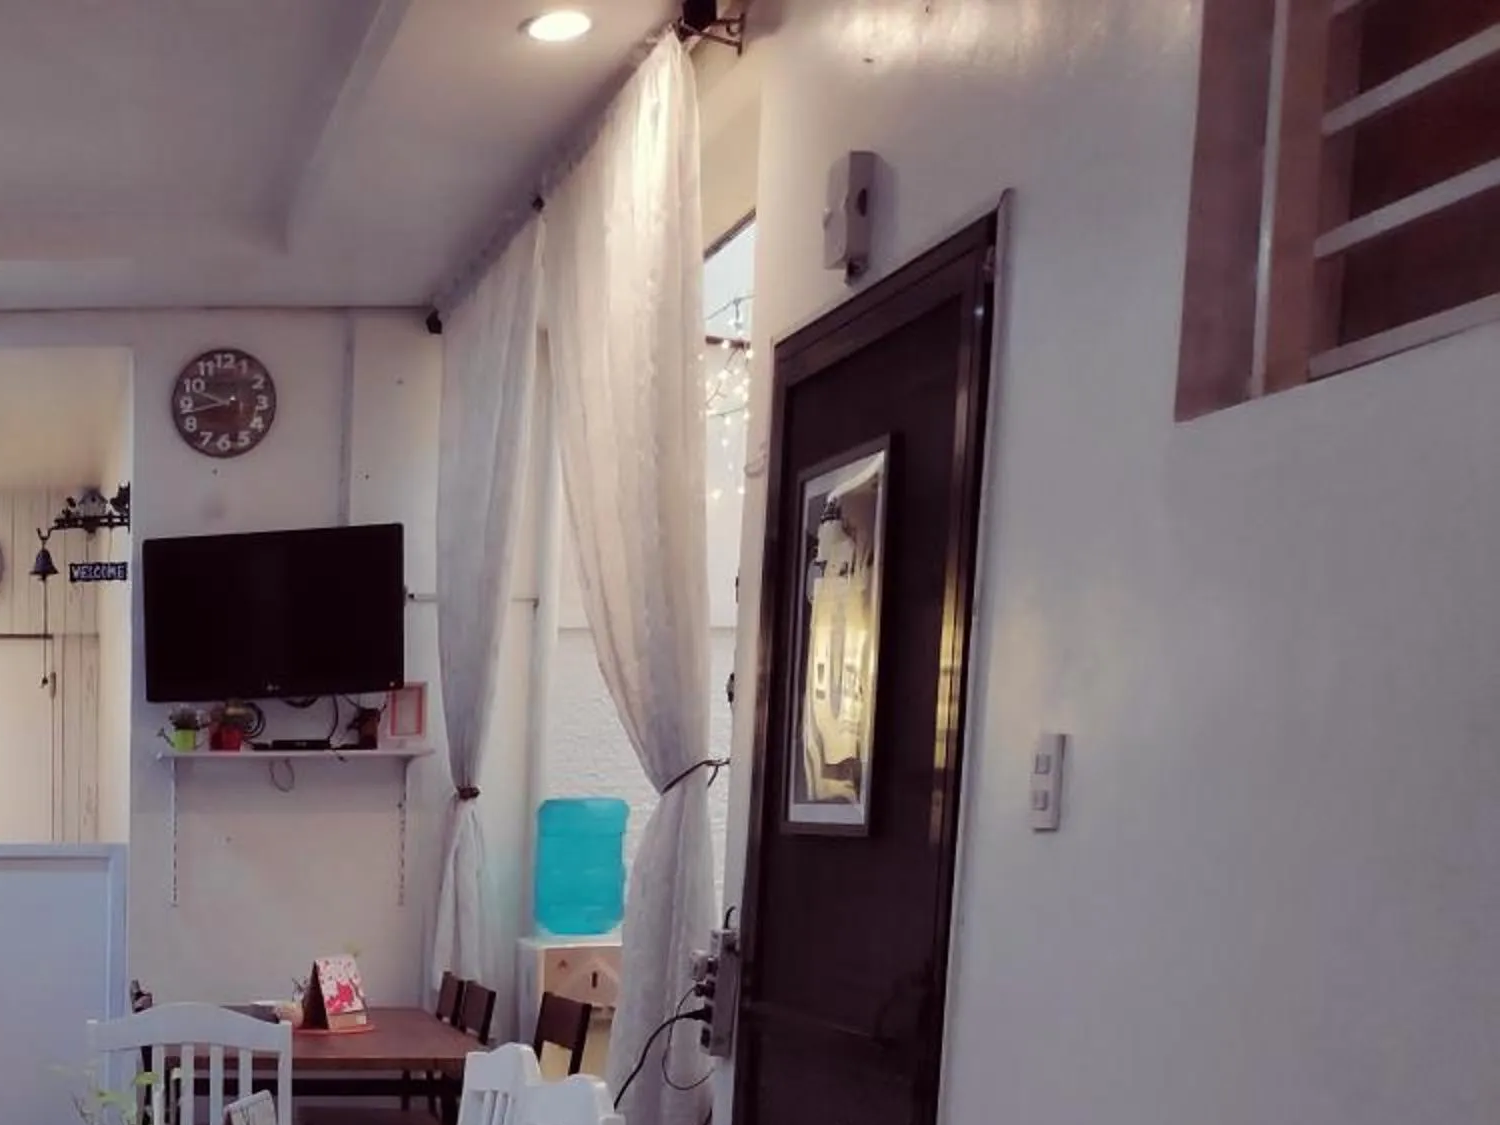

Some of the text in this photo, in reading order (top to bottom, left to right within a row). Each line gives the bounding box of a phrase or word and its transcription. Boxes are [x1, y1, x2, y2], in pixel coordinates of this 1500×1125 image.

[198, 360, 214, 376] 11
[214, 353, 236, 369] 12
[240, 359, 248, 374] 1
[184, 378, 205, 393] 10
[251, 374, 265, 389] 2
[180, 396, 194, 413] 9
[255, 395, 268, 411] 3
[184, 416, 197, 433] 8
[250, 416, 264, 432] 4
[200, 431, 213, 446] 7
[217, 433, 231, 451] 6
[238, 431, 250, 447] 5
[71, 564, 126, 580] WELCOME
